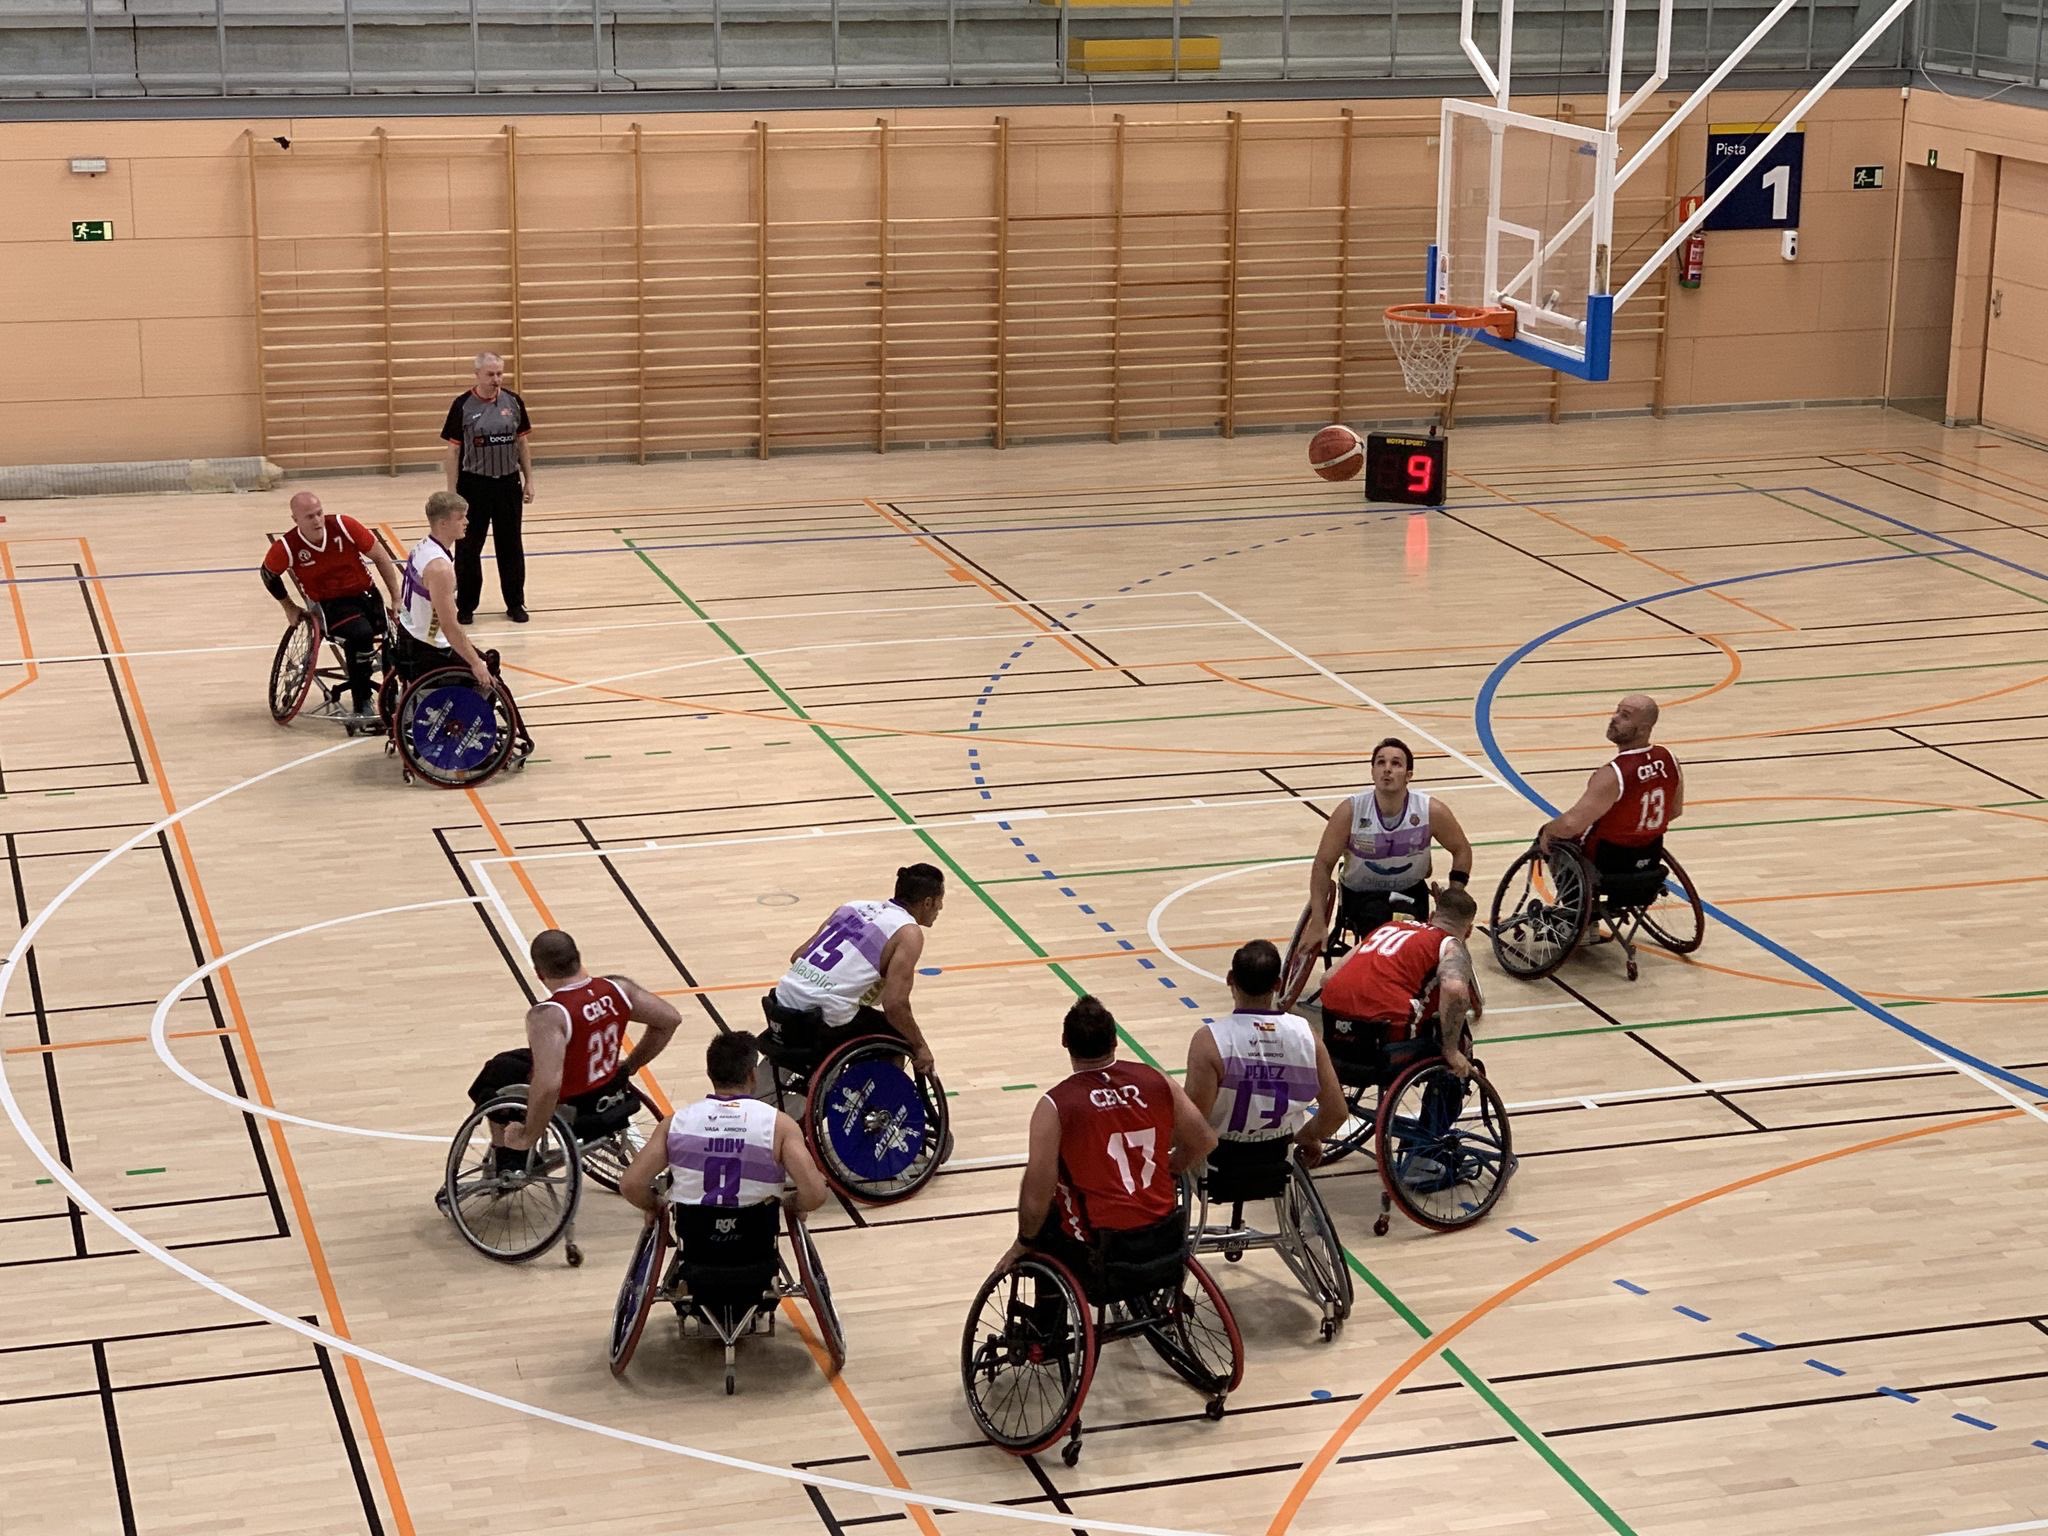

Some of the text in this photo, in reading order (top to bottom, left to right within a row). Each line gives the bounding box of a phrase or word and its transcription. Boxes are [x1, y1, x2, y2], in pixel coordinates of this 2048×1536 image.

[1716, 143, 1746, 155] Pista
[1762, 166, 1790, 219] 1
[489, 435, 514, 443] bequa
[1408, 455, 1432, 491] 9
[1636, 787, 1665, 832] 13
[1358, 925, 1419, 957] 90
[587, 1021, 619, 1084] 23
[1227, 1080, 1289, 1134] 13
[701, 1157, 741, 1208] 8
[1107, 1127, 1156, 1195] 17
